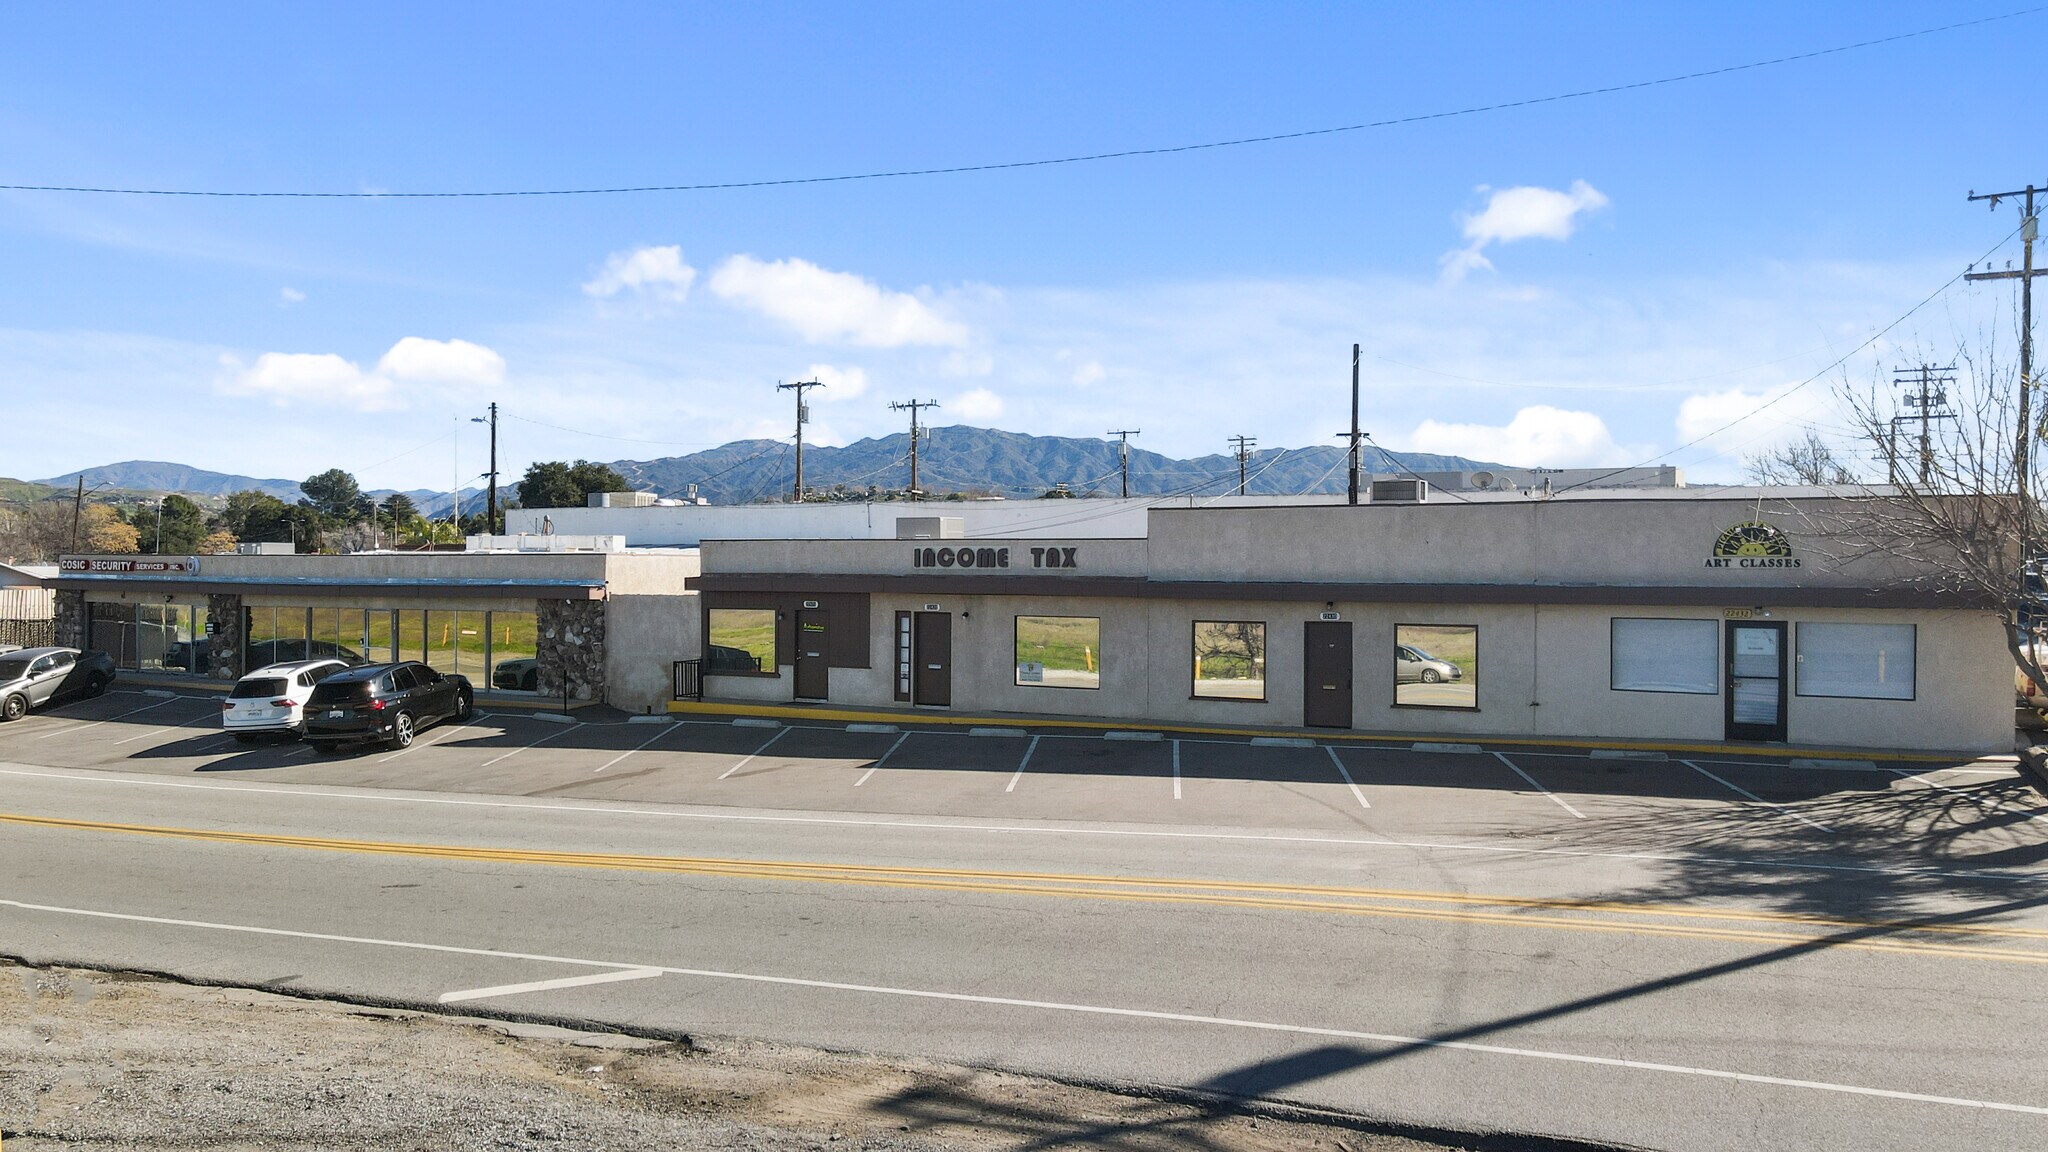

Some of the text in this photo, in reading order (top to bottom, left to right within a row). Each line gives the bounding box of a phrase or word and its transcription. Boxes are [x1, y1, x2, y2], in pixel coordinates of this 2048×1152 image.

[913, 547, 1077, 568] INCOME TAX
[1704, 558, 1801, 568] ART CLASSES
[61, 560, 86, 570] COSIC
[91, 560, 132, 571] SECURITY
